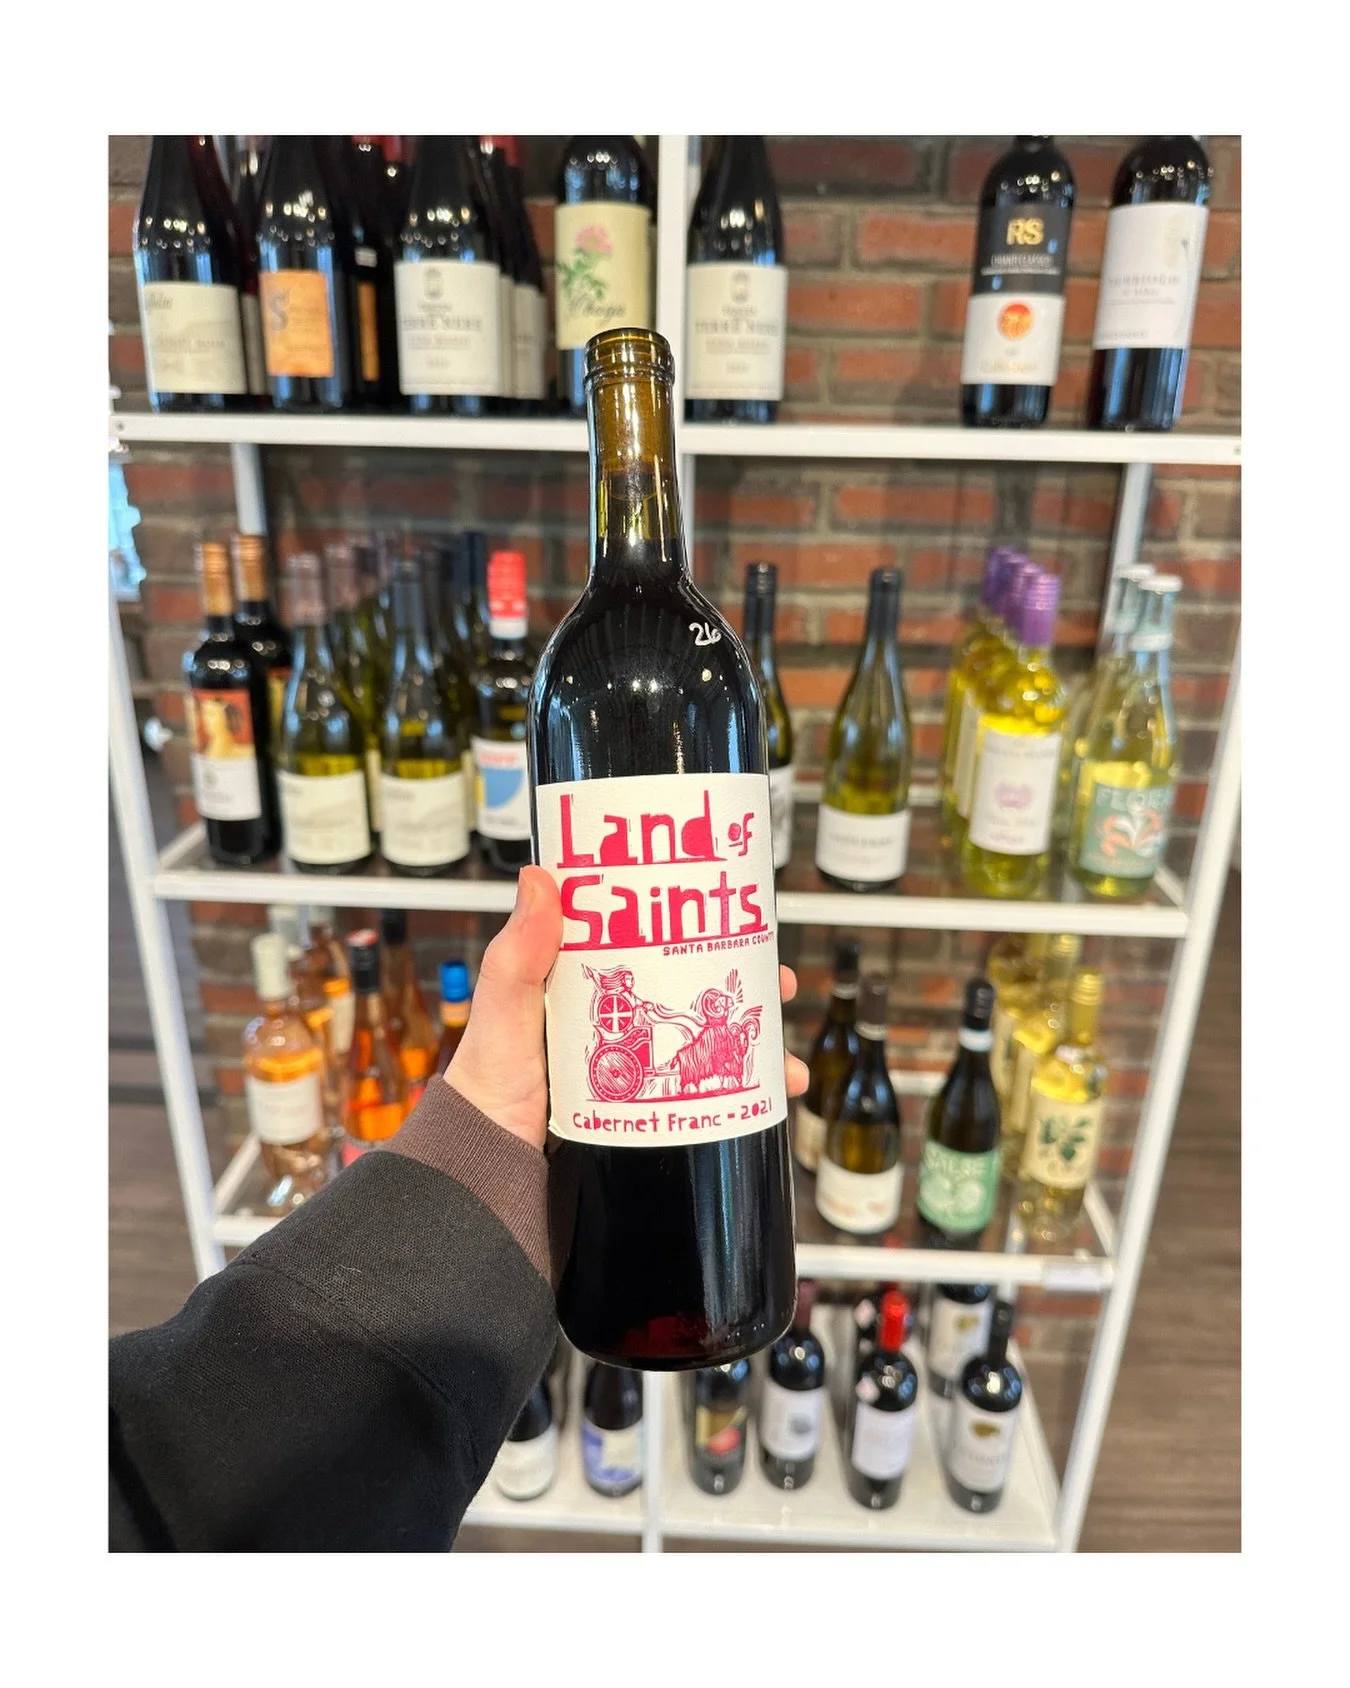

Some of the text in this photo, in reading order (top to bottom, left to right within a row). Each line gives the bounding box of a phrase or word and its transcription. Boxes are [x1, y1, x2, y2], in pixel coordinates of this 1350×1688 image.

[1006, 217, 1045, 246] RS
[688, 622, 721, 646] 26
[557, 790, 755, 869] Land of
[559, 871, 768, 951] Saints
[663, 943, 703, 956] SANTA
[707, 937, 750, 952] BARBARA
[572, 1109, 660, 1132] Cabernet
[668, 1112, 722, 1131] Franc
[741, 1097, 772, 1120] 2021
